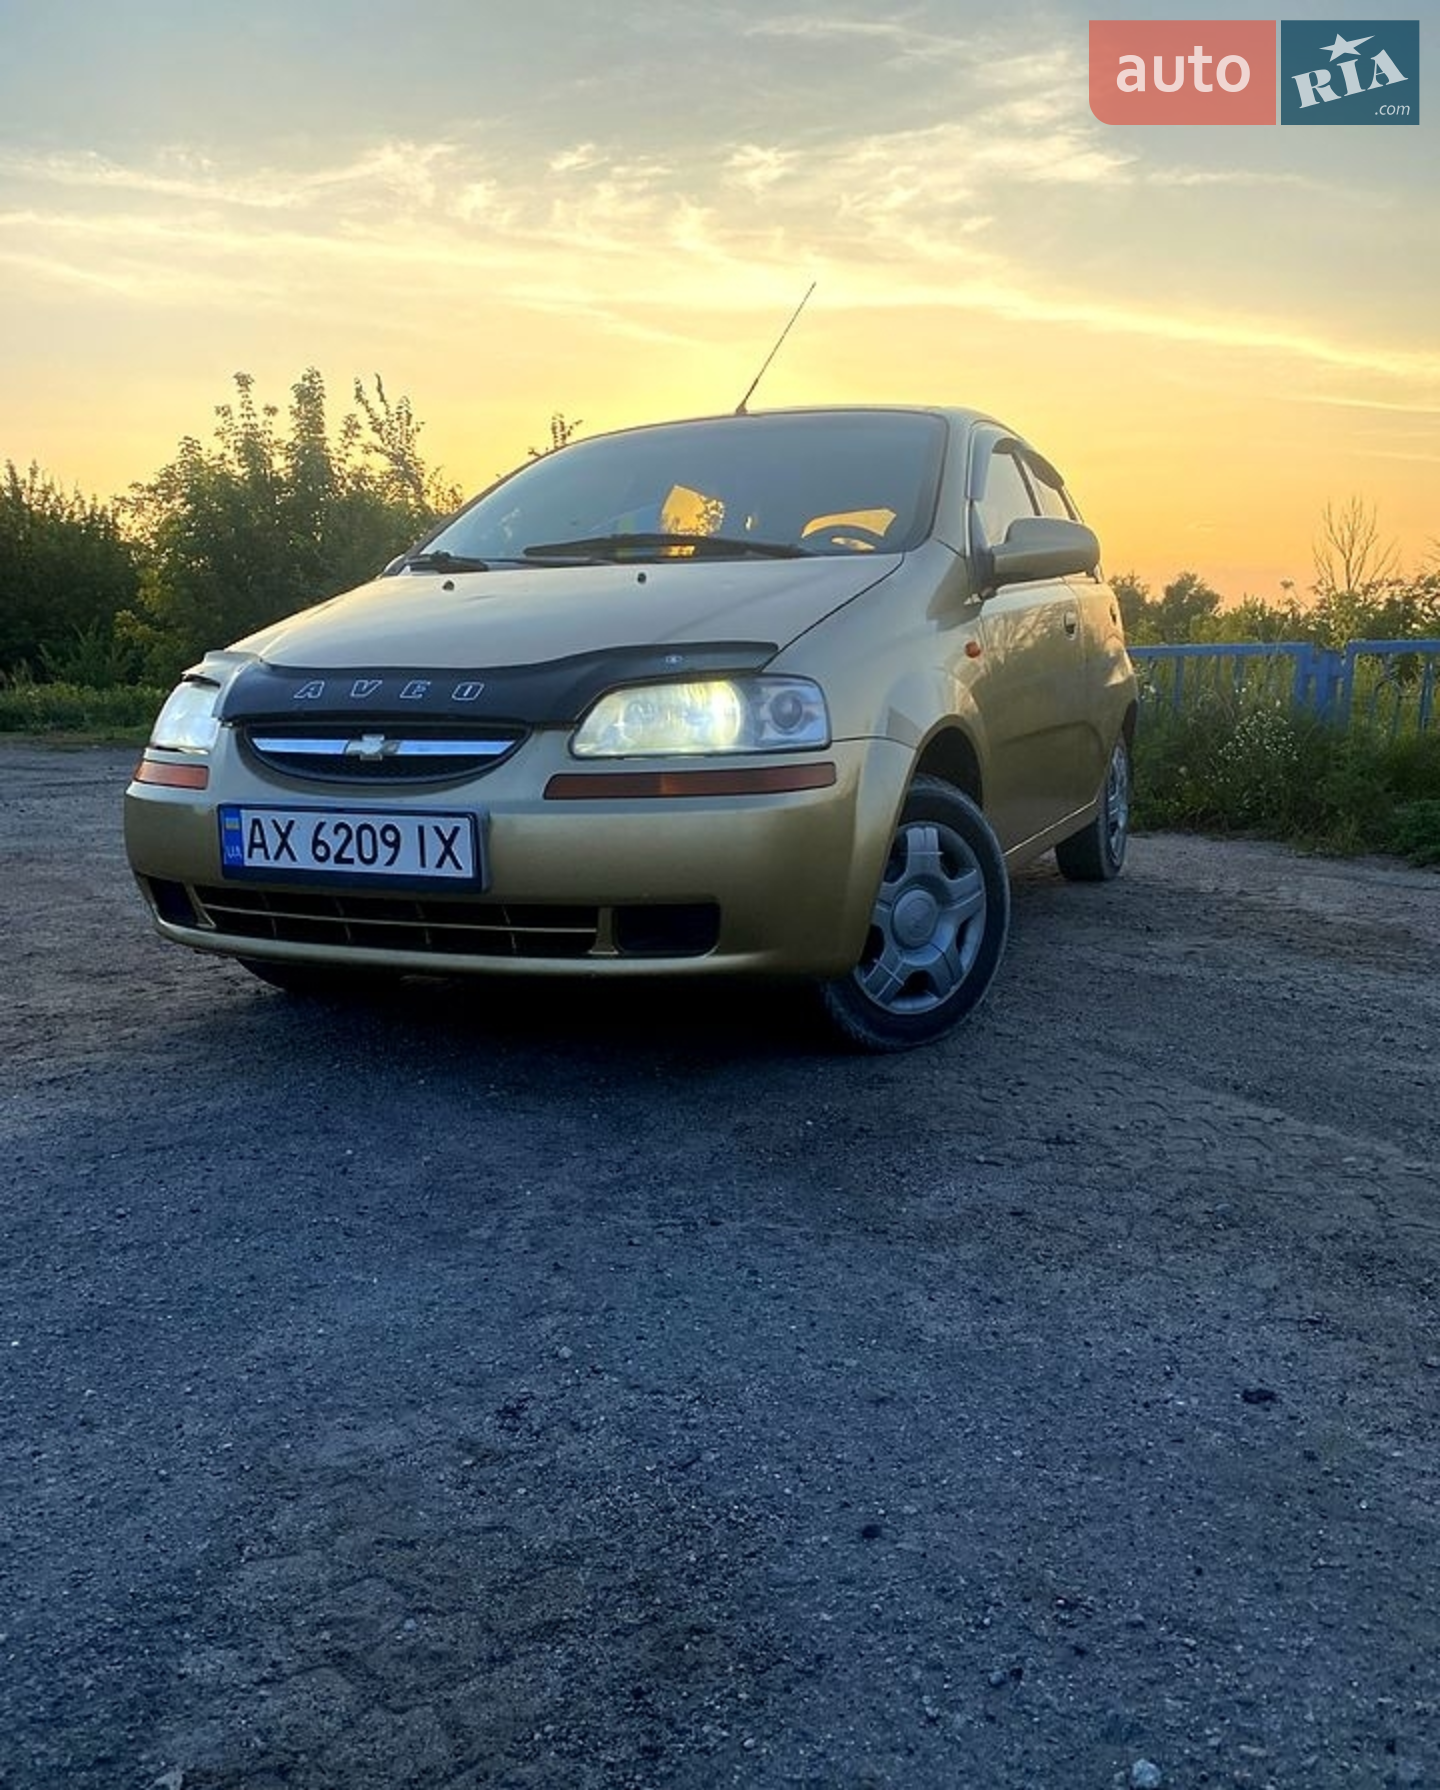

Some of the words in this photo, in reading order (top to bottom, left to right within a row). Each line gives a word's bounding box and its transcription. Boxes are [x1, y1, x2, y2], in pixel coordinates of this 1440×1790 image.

[294, 680, 485, 701] AVEO
[247, 818, 297, 862] AX
[311, 821, 401, 867] 6209
[417, 824, 463, 871] IX
